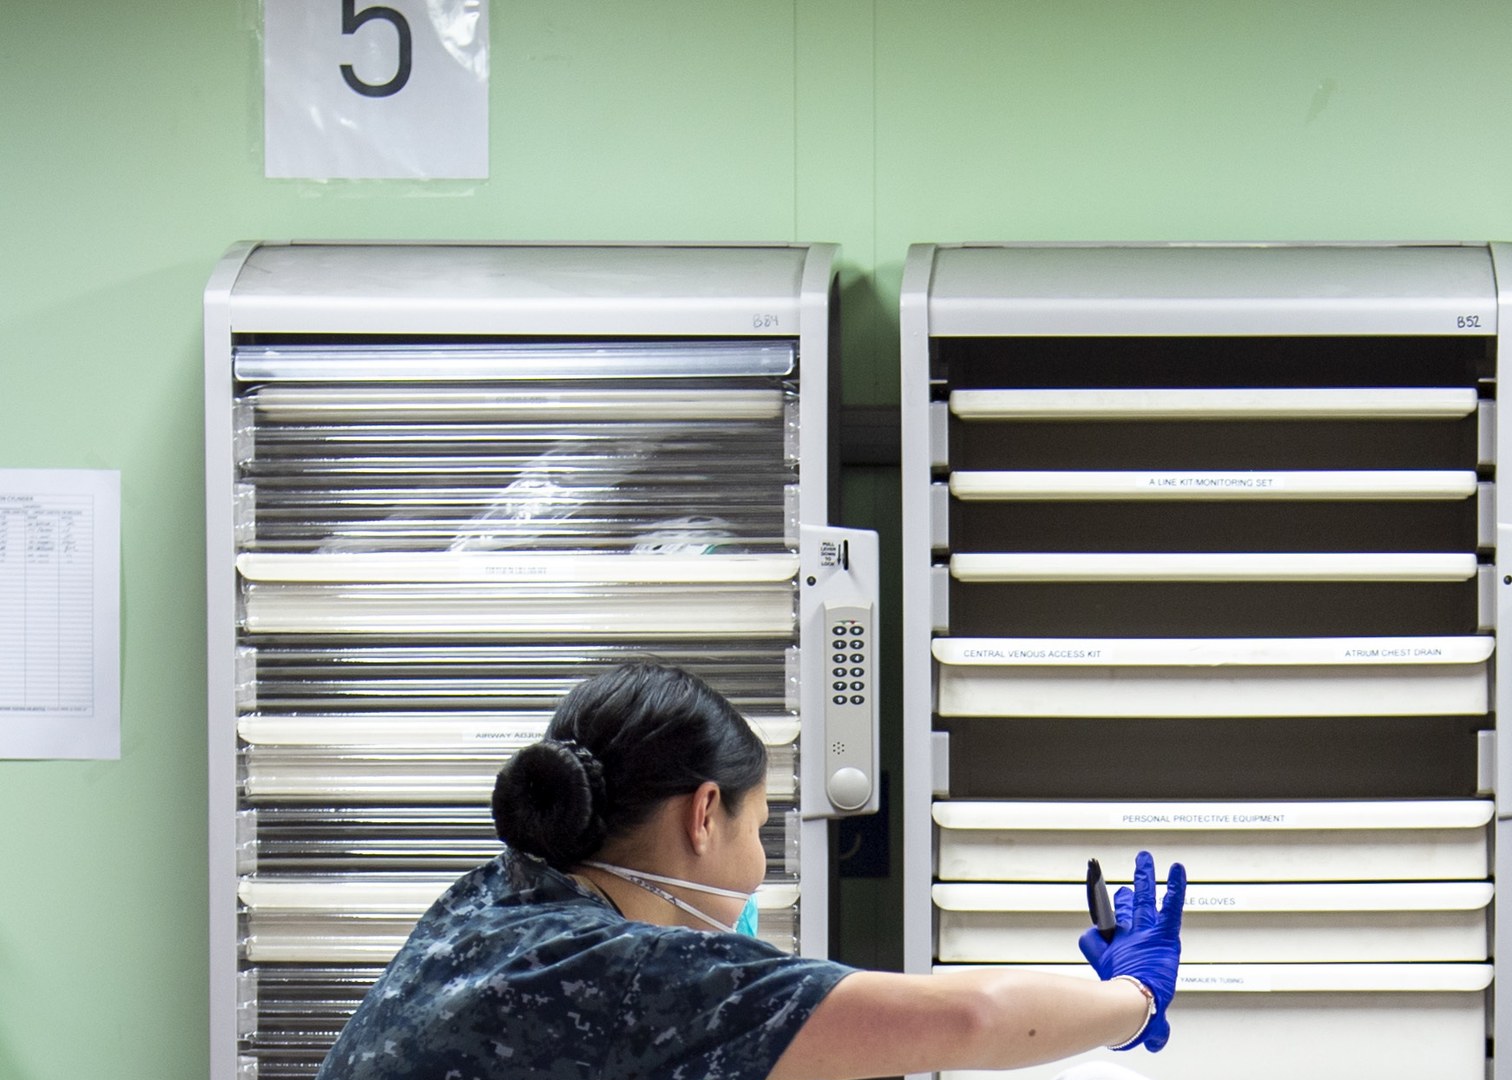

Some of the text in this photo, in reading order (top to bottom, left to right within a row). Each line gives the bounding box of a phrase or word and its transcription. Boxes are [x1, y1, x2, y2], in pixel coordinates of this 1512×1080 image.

[339, 0, 412, 98] 5
[1457, 315, 1482, 328] B52
[1158, 478, 1176, 486] LINE
[1256, 478, 1273, 487] SET
[963, 650, 1004, 658] CENTRAL
[1123, 814, 1285, 822] PERSONAL PROTECTIVE EQUIPMENT
